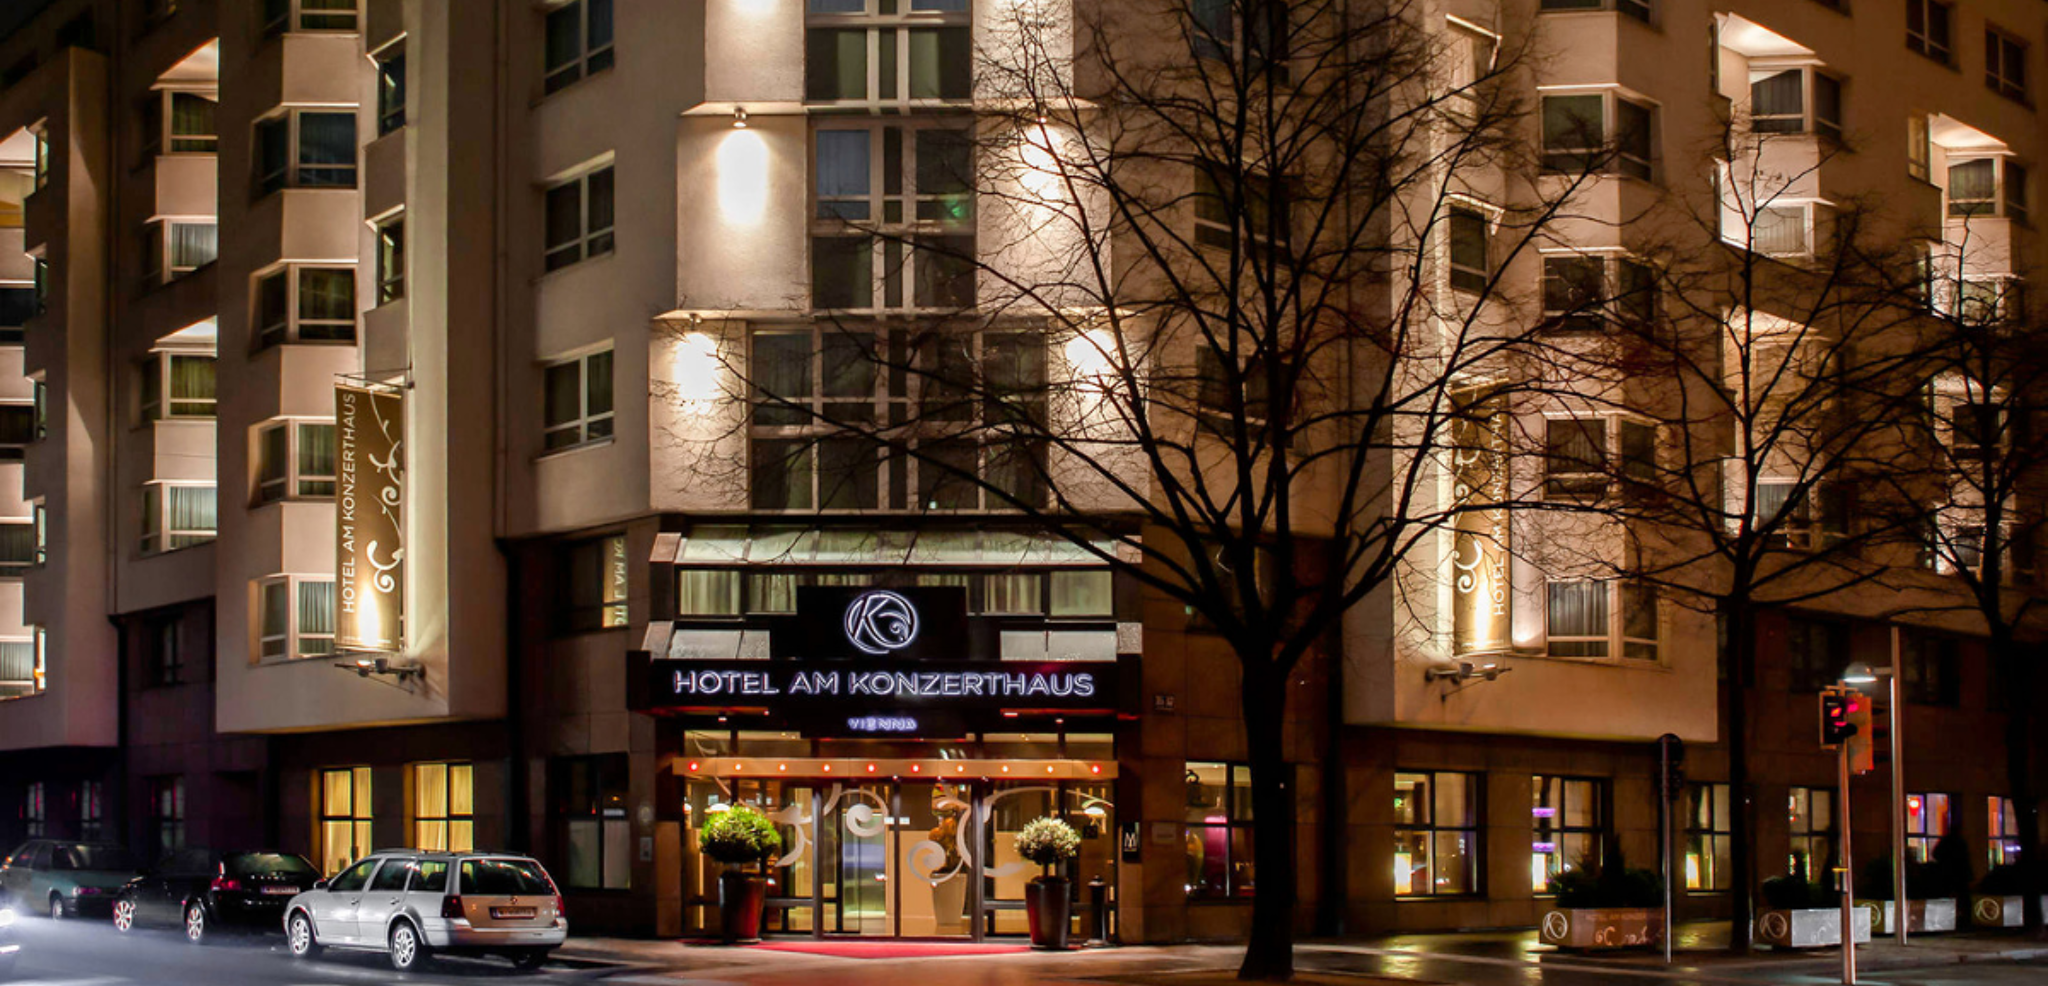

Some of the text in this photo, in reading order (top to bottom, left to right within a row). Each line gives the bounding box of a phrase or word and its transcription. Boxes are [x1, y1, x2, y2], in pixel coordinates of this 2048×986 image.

[342, 393, 356, 613] HOTEL AM KONZERTHAUS
[1493, 525, 1505, 551] AM
[1493, 558, 1504, 615] HOTEL
[674, 670, 1095, 696] HOTEL AM KONZERTHAUS
[847, 717, 918, 731] VIENNA
